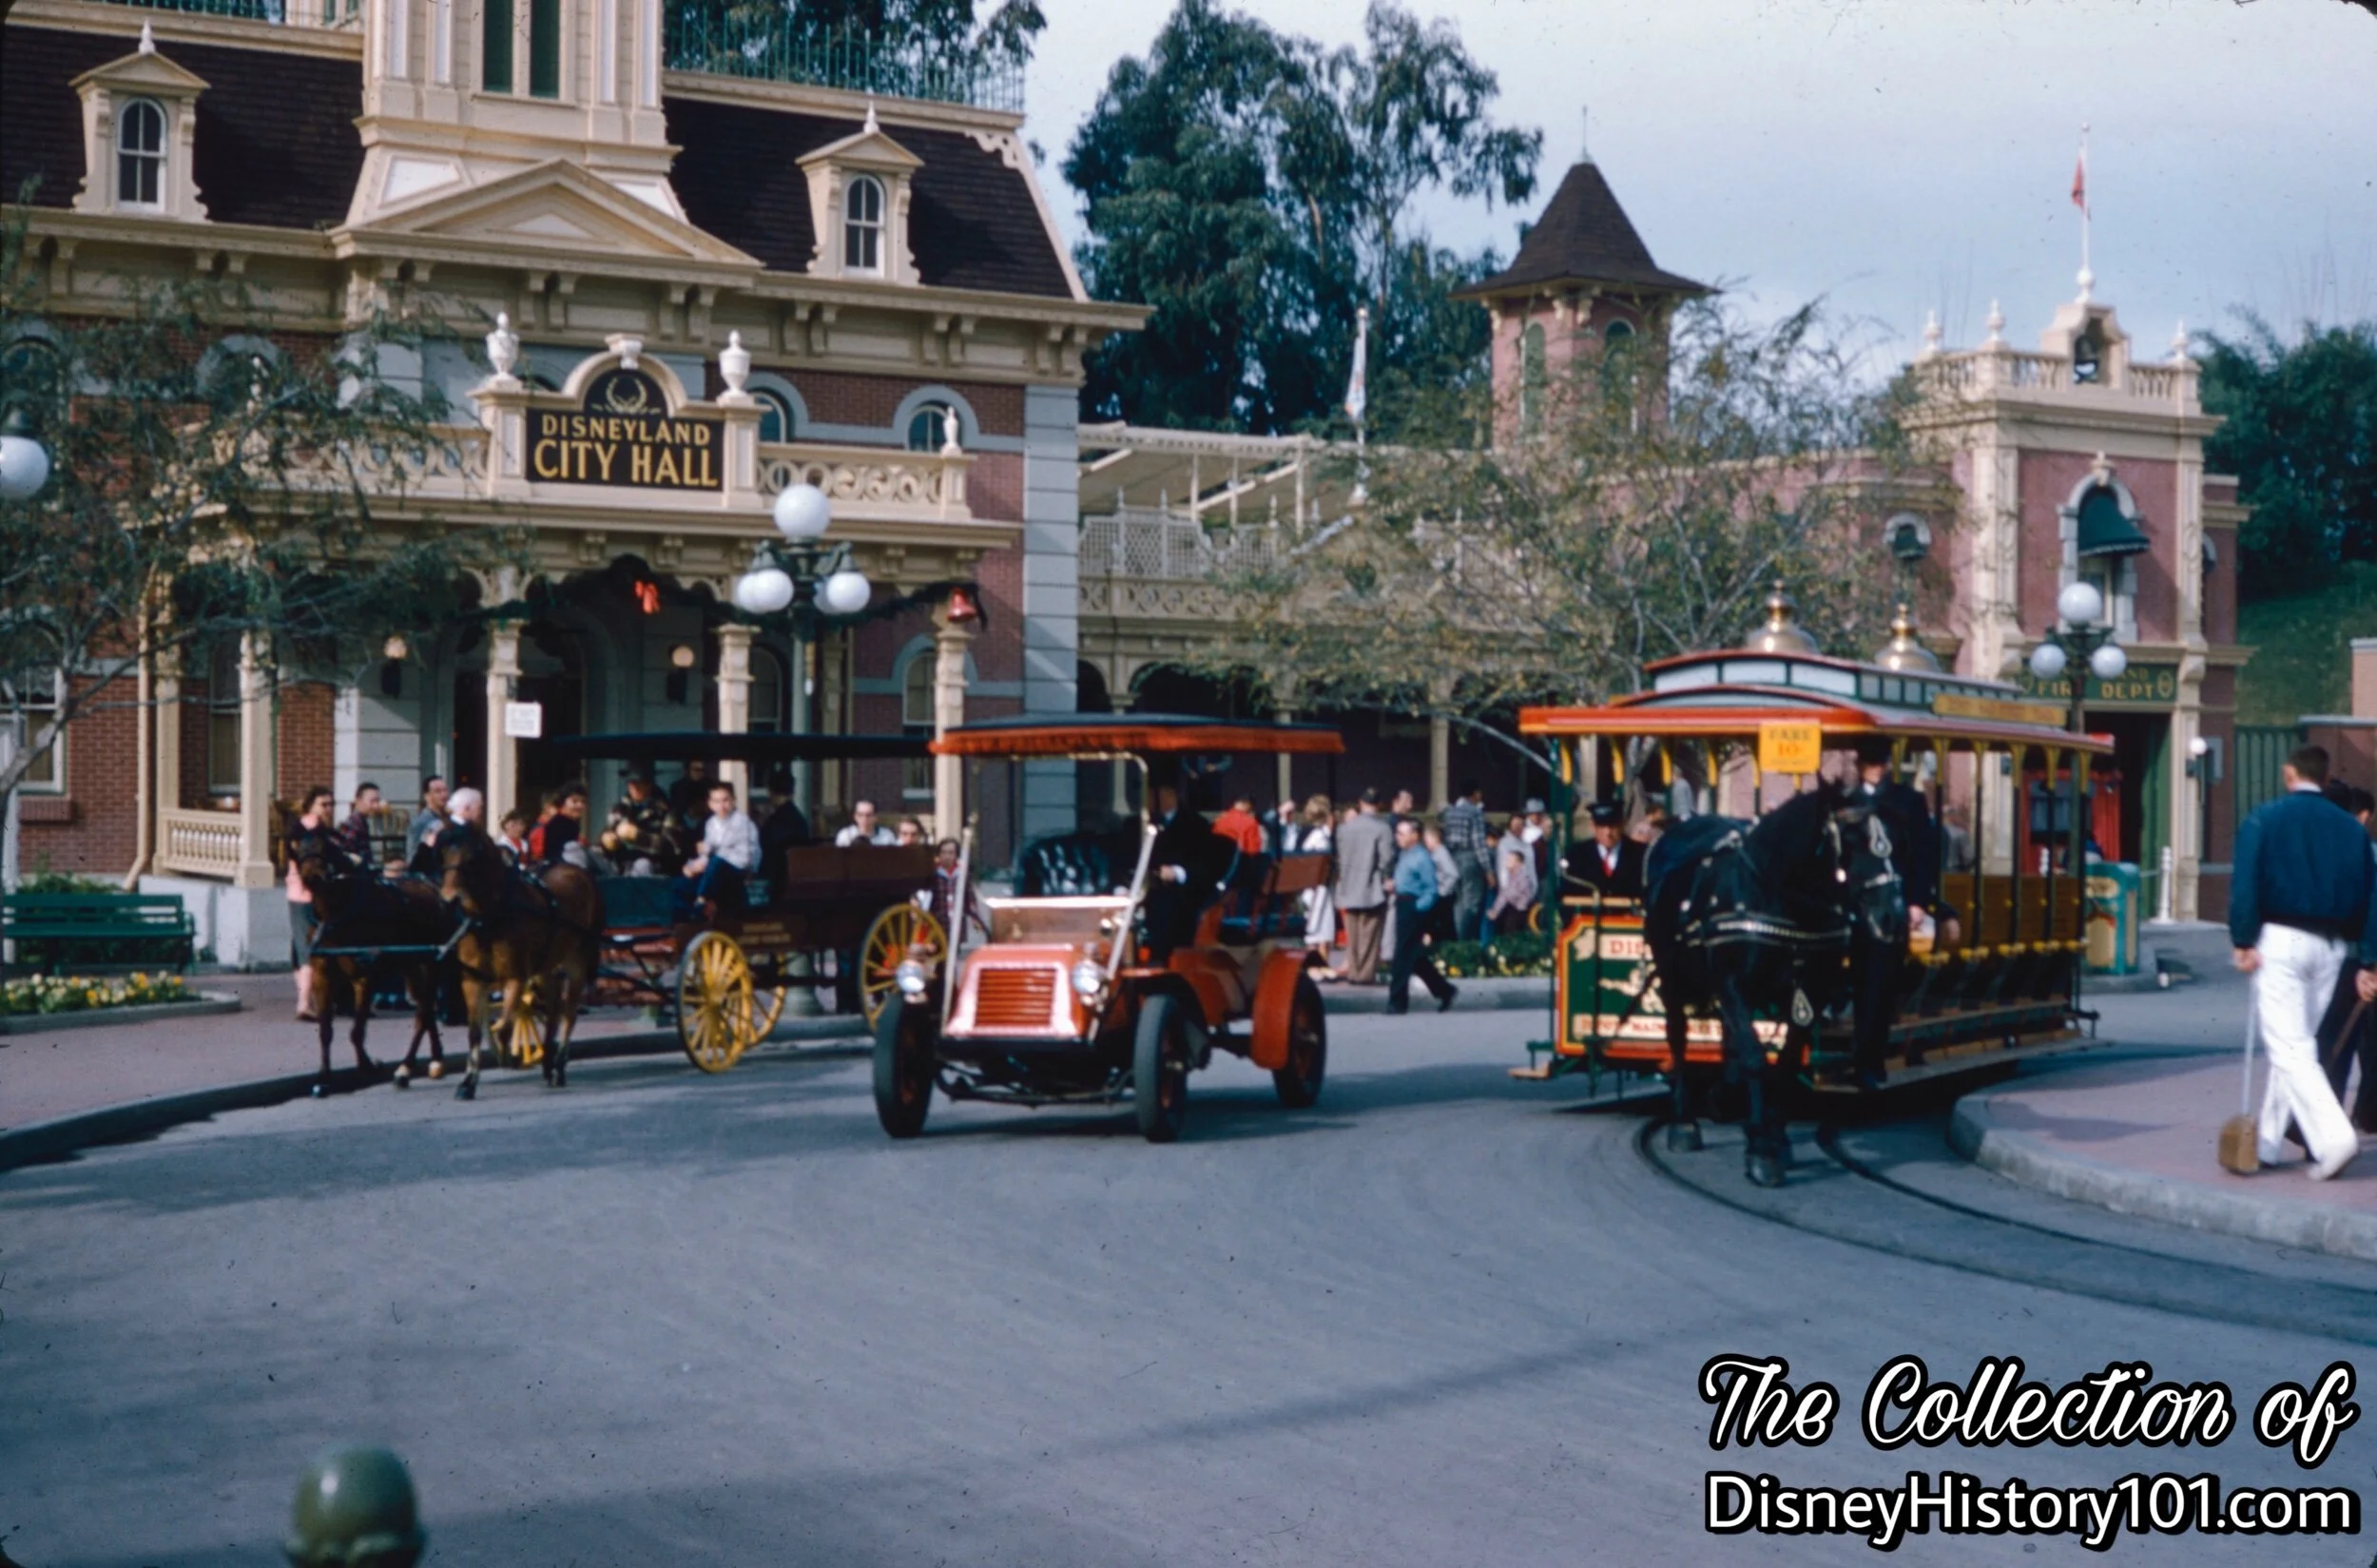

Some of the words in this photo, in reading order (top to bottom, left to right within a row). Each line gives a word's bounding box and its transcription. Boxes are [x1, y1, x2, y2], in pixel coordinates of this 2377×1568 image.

[542, 414, 710, 445] DISNEYLAND
[534, 439, 616, 480] CITY
[631, 444, 718, 487] HALL
[2037, 680, 2074, 696] FIR
[2101, 682, 2155, 700] DEPT
